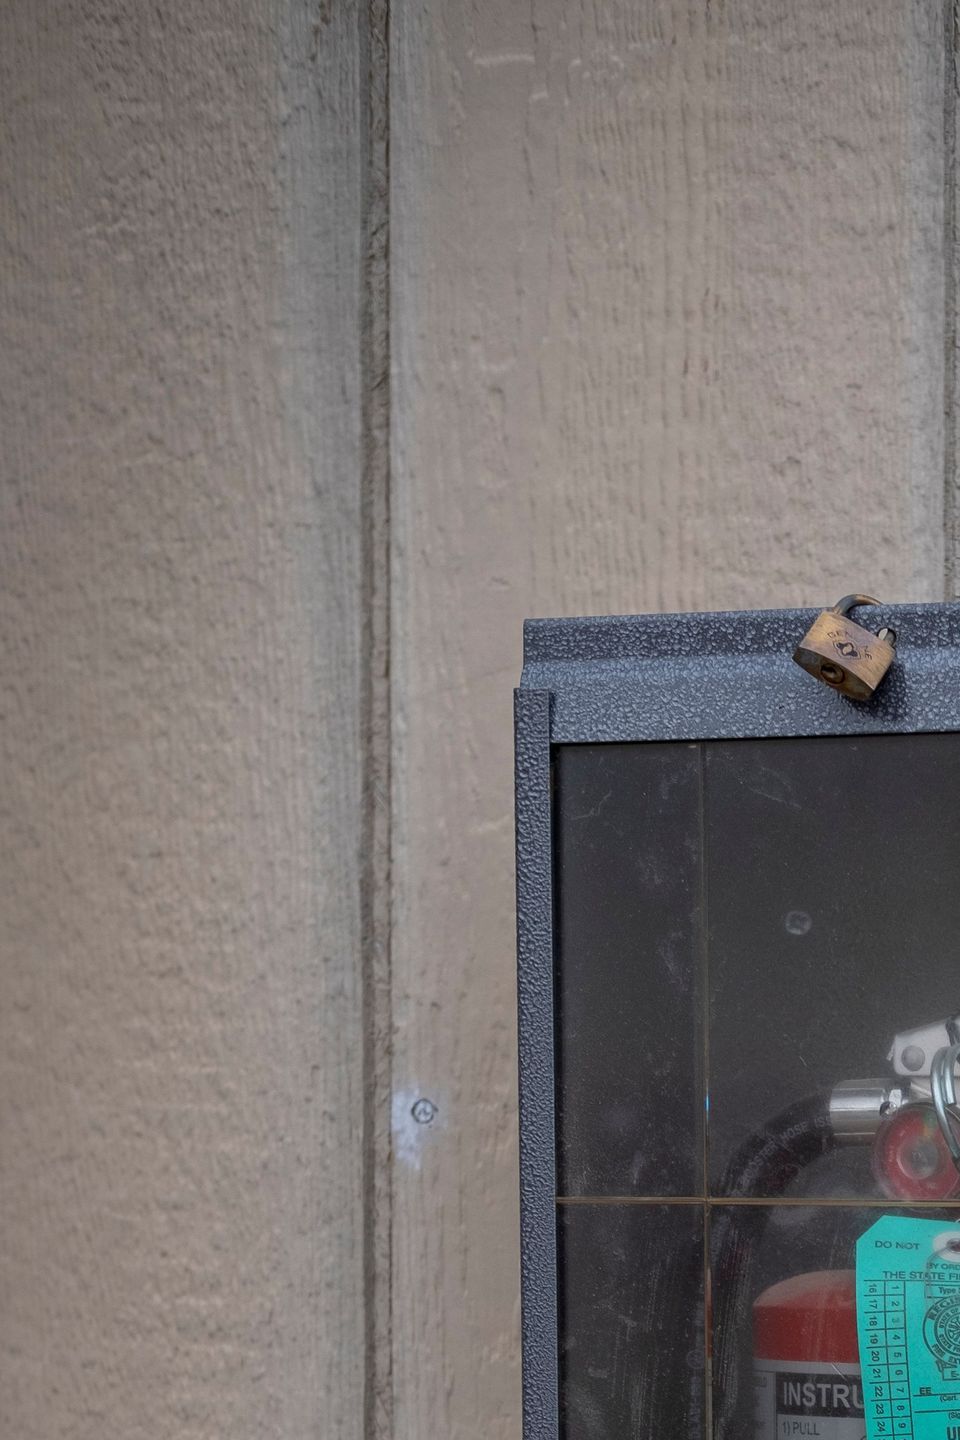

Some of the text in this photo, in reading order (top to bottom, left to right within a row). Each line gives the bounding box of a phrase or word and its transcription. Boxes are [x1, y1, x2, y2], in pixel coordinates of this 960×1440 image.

[875, 1240, 892, 1249] DO
[895, 1241, 920, 1250] NOT
[883, 1270, 906, 1280] THE
[909, 1271, 945, 1281] STATE
[868, 1282, 877, 1293] 16
[938, 1286, 956, 1295] Type
[869, 1299, 878, 1310] 17
[869, 1316, 878, 1326] 18
[871, 1334, 879, 1344] 19
[871, 1351, 879, 1362] 20
[872, 1368, 881, 1379] 21
[783, 1381, 864, 1409] INSTRU
[875, 1386, 883, 1397] 22
[919, 1386, 931, 1394] EE
[940, 1394, 959, 1402] (Cert.
[876, 1403, 884, 1414] 23
[782, 1420, 791, 1435] 1)
[792, 1421, 820, 1436] PULL
[877, 1421, 885, 1432] 24
